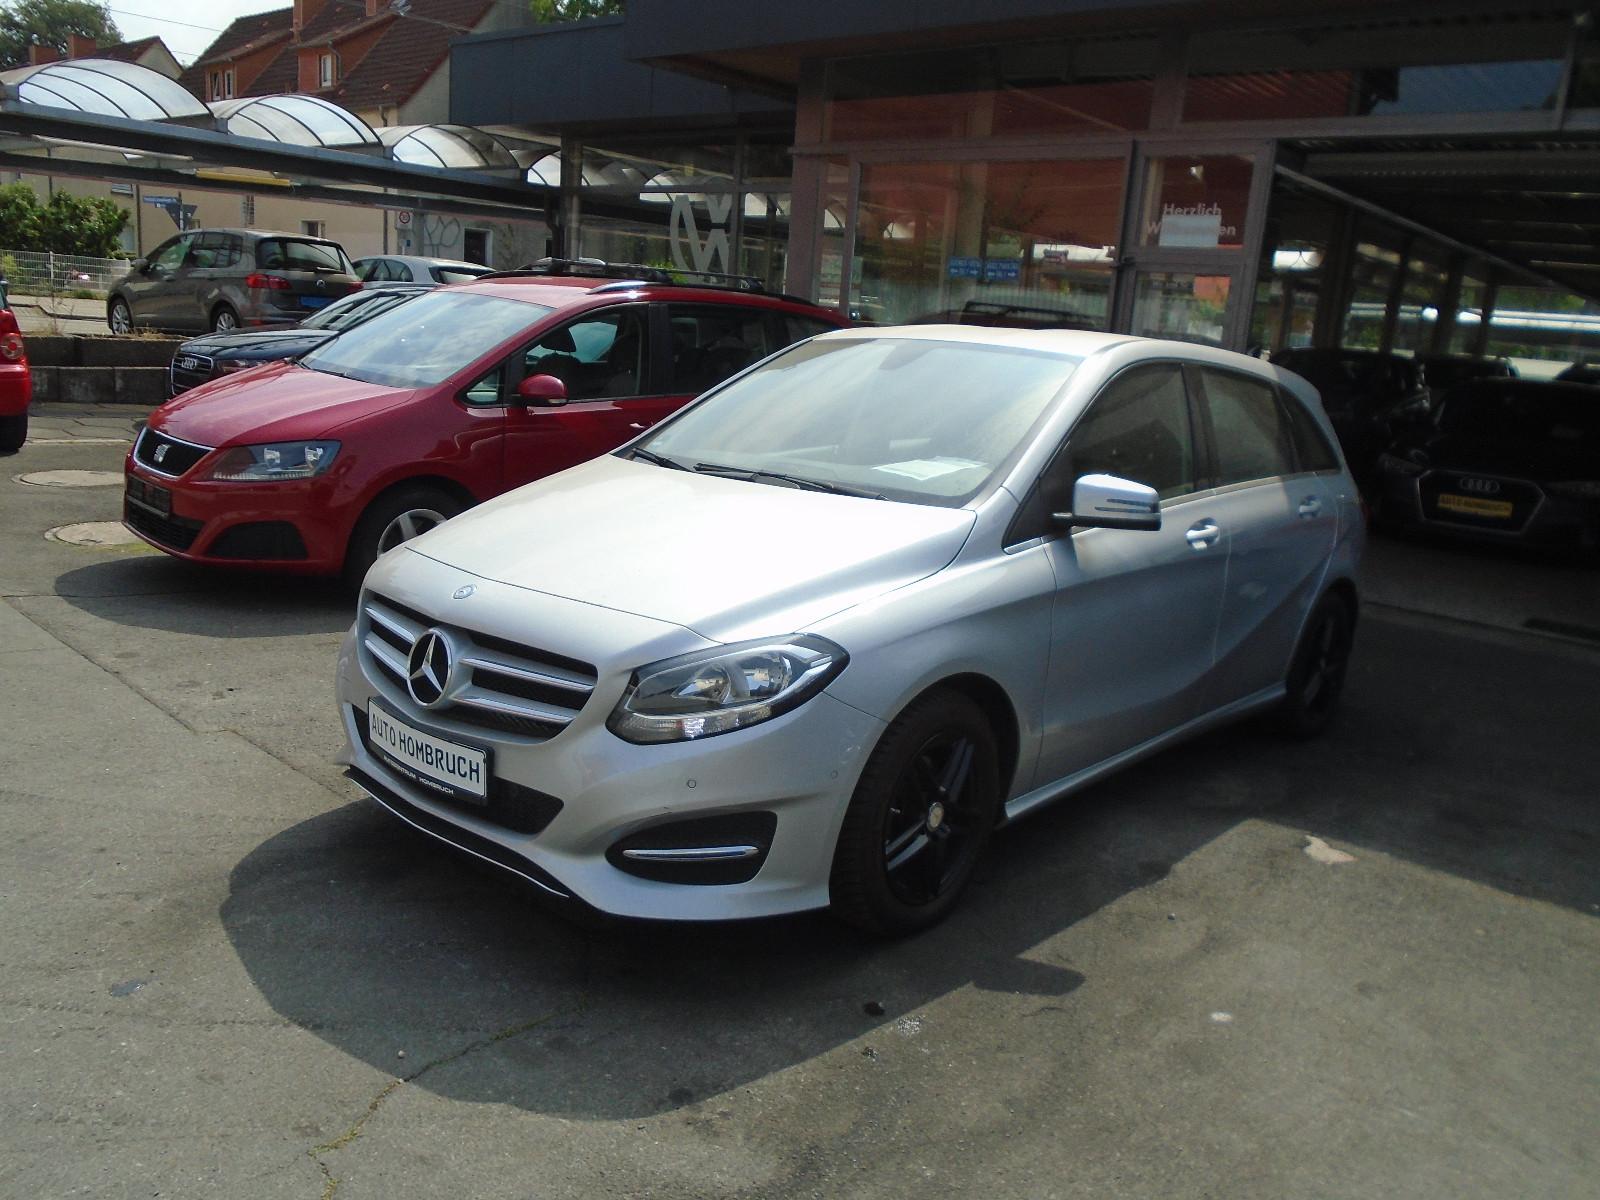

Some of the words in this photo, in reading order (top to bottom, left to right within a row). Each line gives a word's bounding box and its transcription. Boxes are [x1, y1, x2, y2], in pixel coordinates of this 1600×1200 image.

[1163, 202, 1222, 216] Herzlich
[371, 713, 396, 746] AUTO
[399, 730, 480, 784] HOMBRUCH
